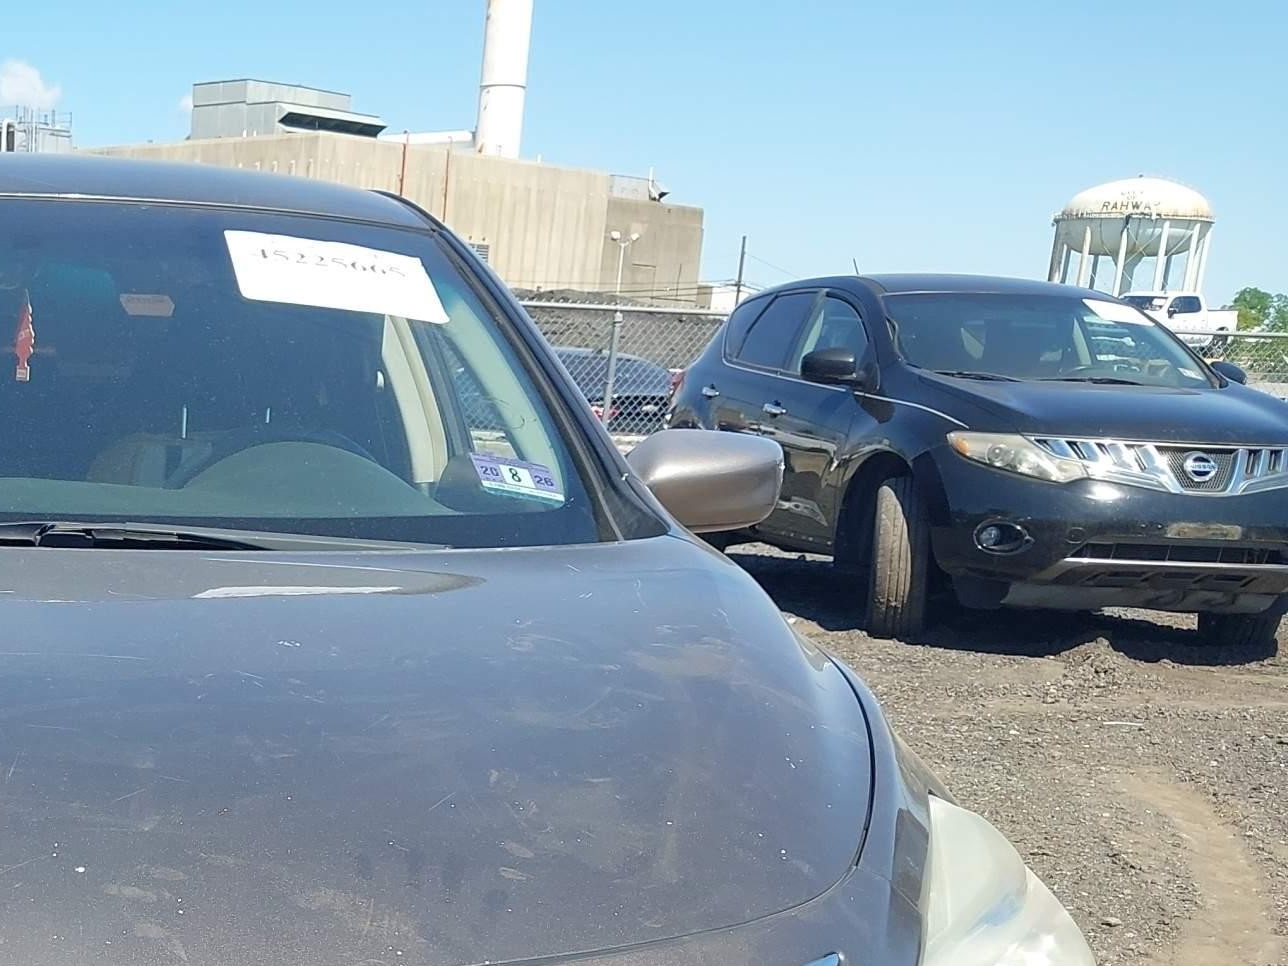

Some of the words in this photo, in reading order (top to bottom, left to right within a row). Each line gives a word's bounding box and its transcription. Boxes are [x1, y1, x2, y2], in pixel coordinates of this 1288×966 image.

[480, 465, 500, 477] 20
[508, 467, 522, 483] 8
[533, 474, 555, 487] 26
